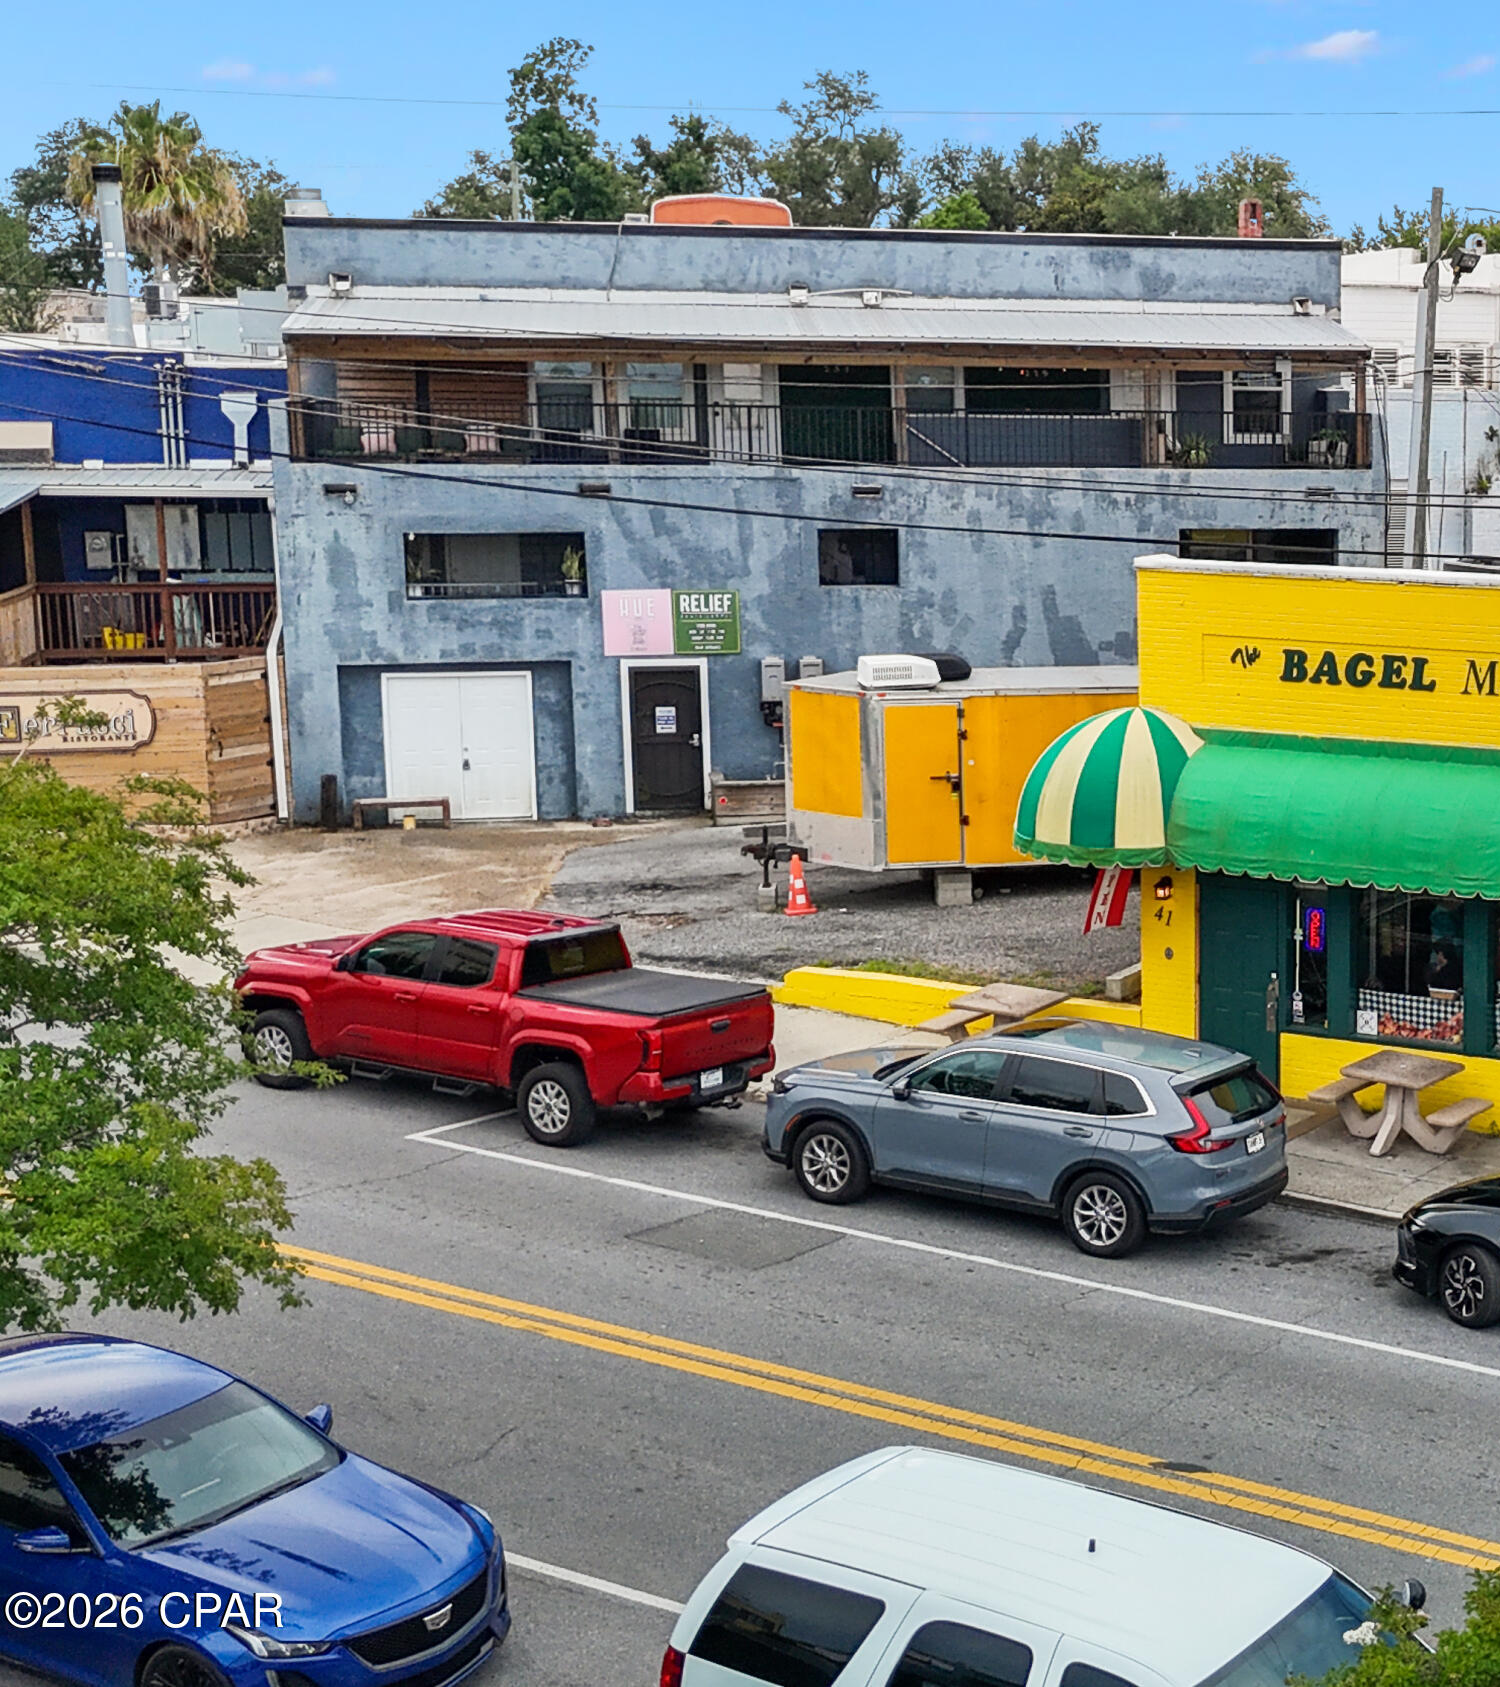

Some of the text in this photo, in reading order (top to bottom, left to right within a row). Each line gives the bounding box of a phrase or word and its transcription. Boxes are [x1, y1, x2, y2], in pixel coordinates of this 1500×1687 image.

[620, 598, 655, 617] HUE
[680, 594, 732, 612] RELIEF
[1230, 645, 1261, 669] The
[1279, 648, 1437, 693] BAGEL
[62, 734, 137, 742] RISTORANTE
[1154, 905, 1173, 926] 41
